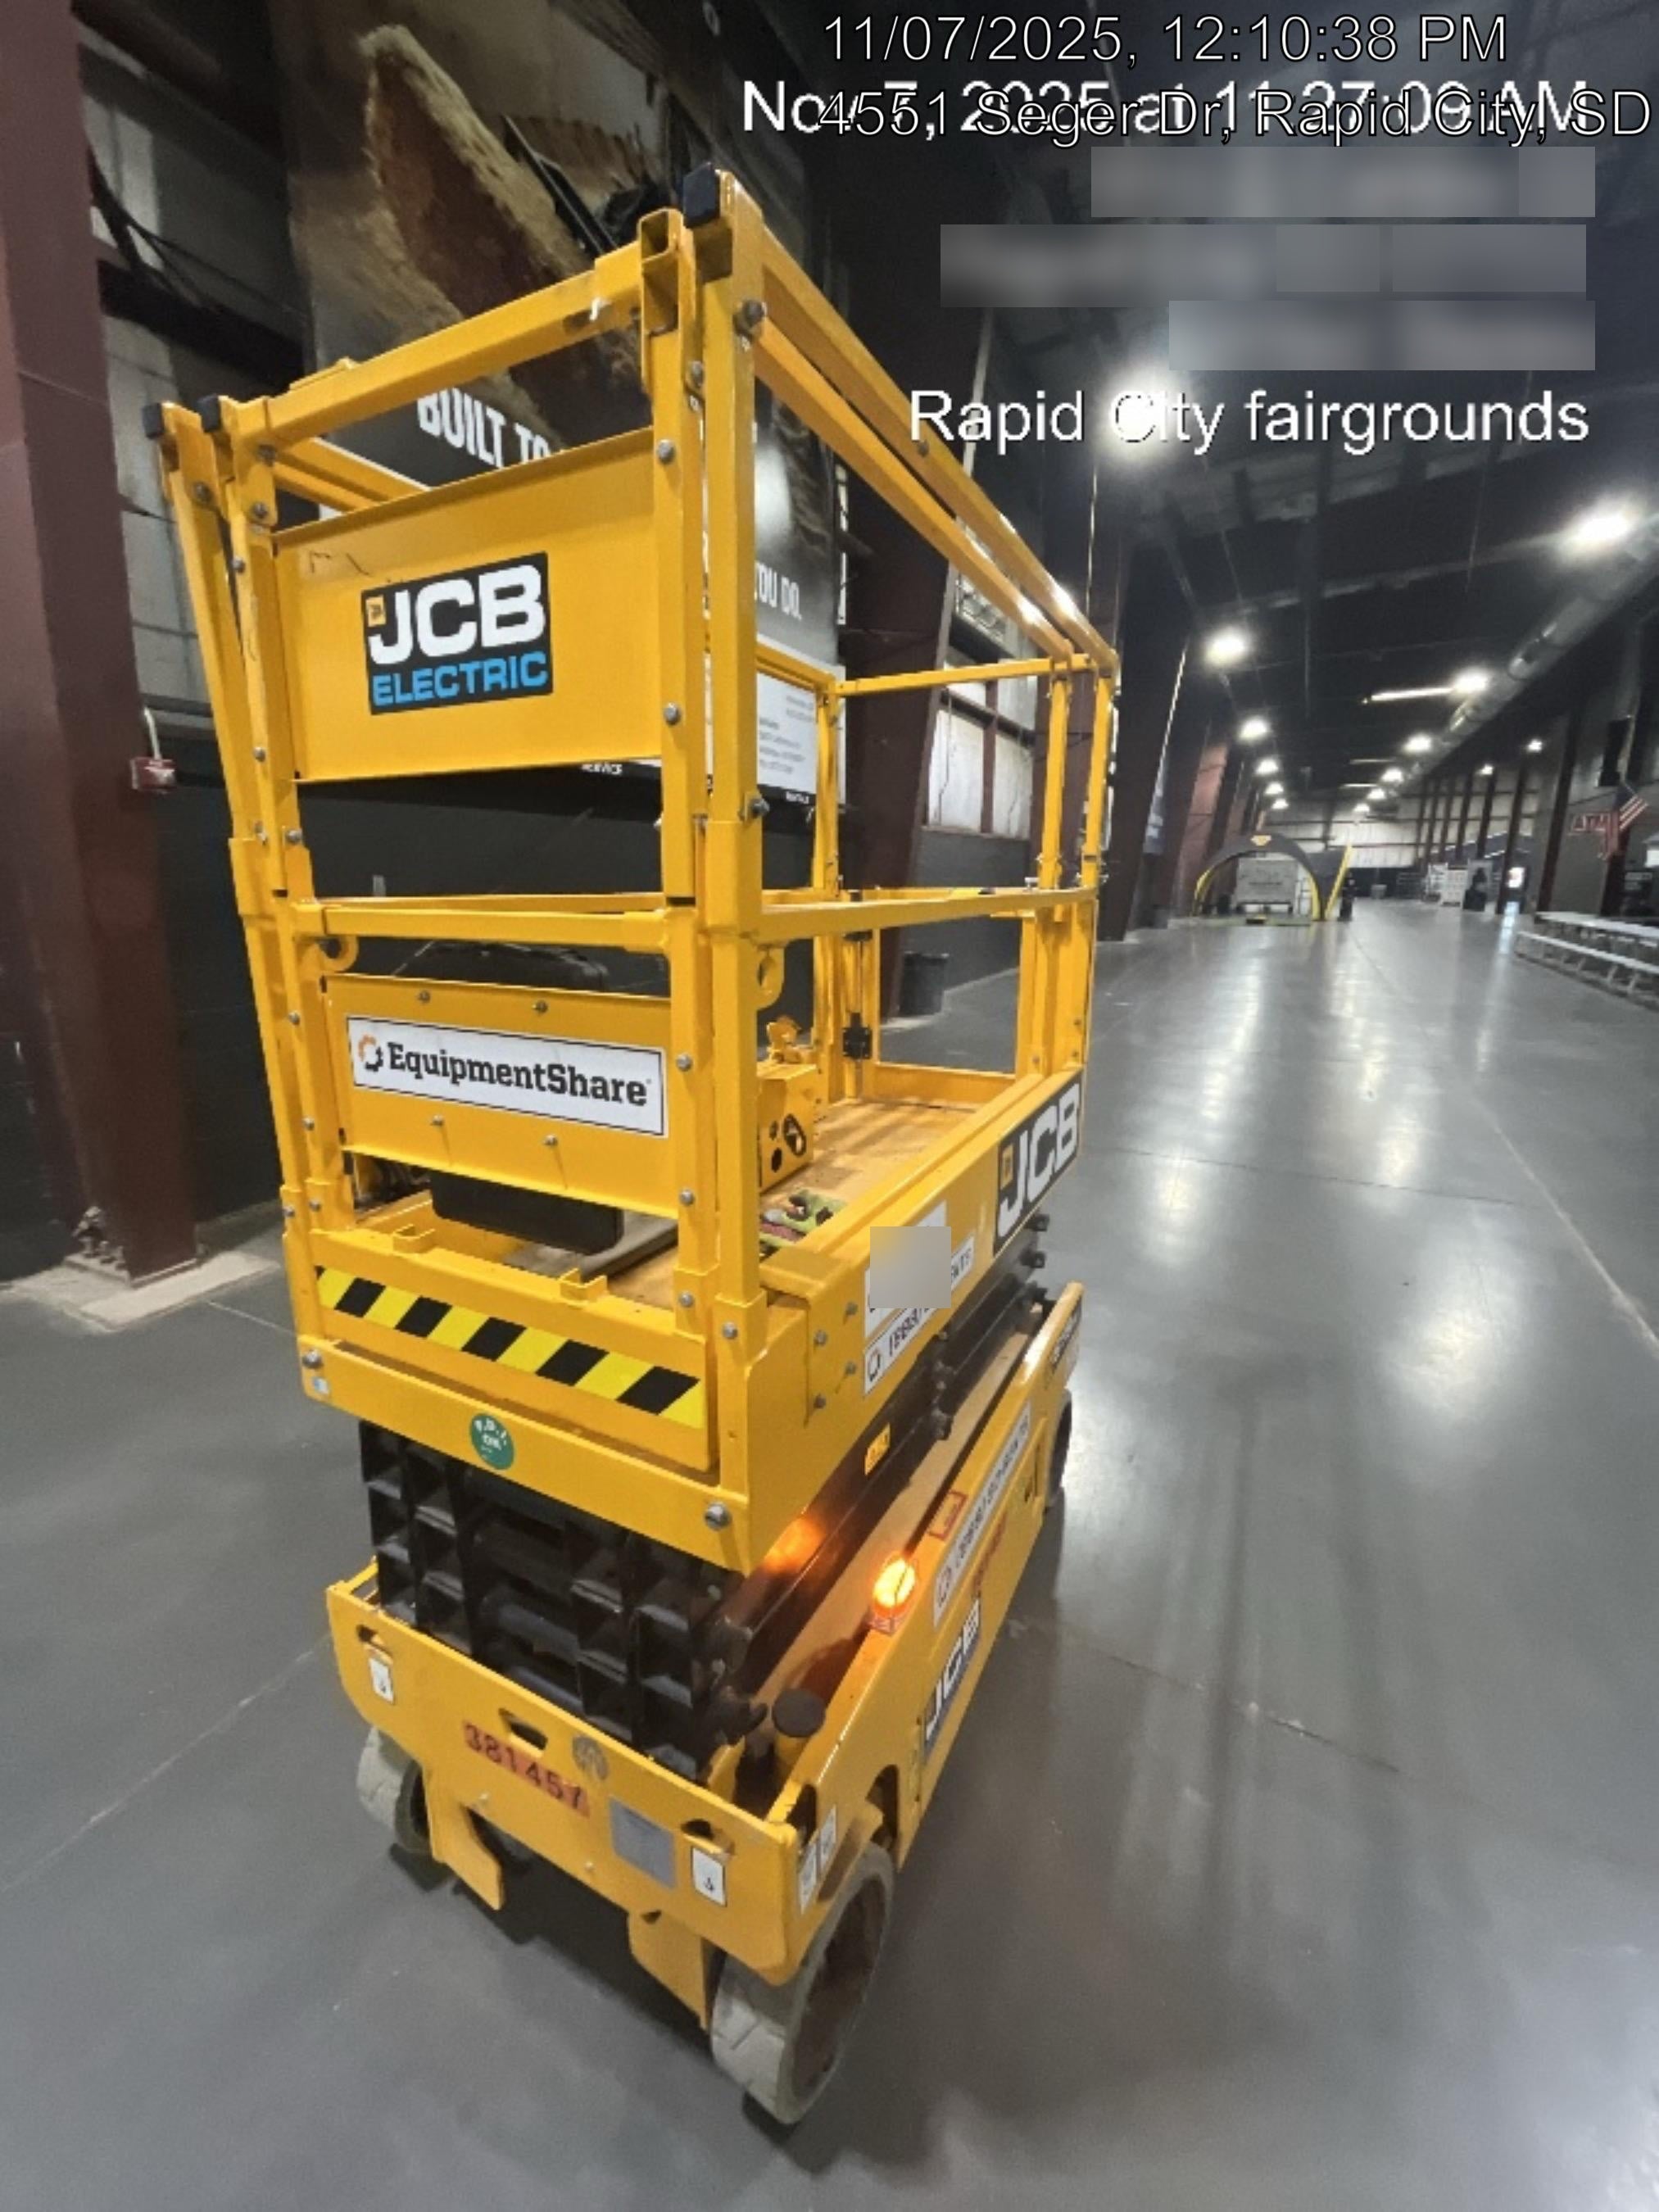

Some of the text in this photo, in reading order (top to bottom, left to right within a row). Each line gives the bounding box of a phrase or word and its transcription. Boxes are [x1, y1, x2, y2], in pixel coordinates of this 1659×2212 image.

[416, 386, 507, 469] BUILT
[366, 564, 546, 665] JCB
[372, 650, 549, 707] ELECTRIC
[388, 1041, 647, 1107] EquipmentShare
[997, 1082, 1081, 1238] JCB
[925, 1598, 981, 1742] JCB
